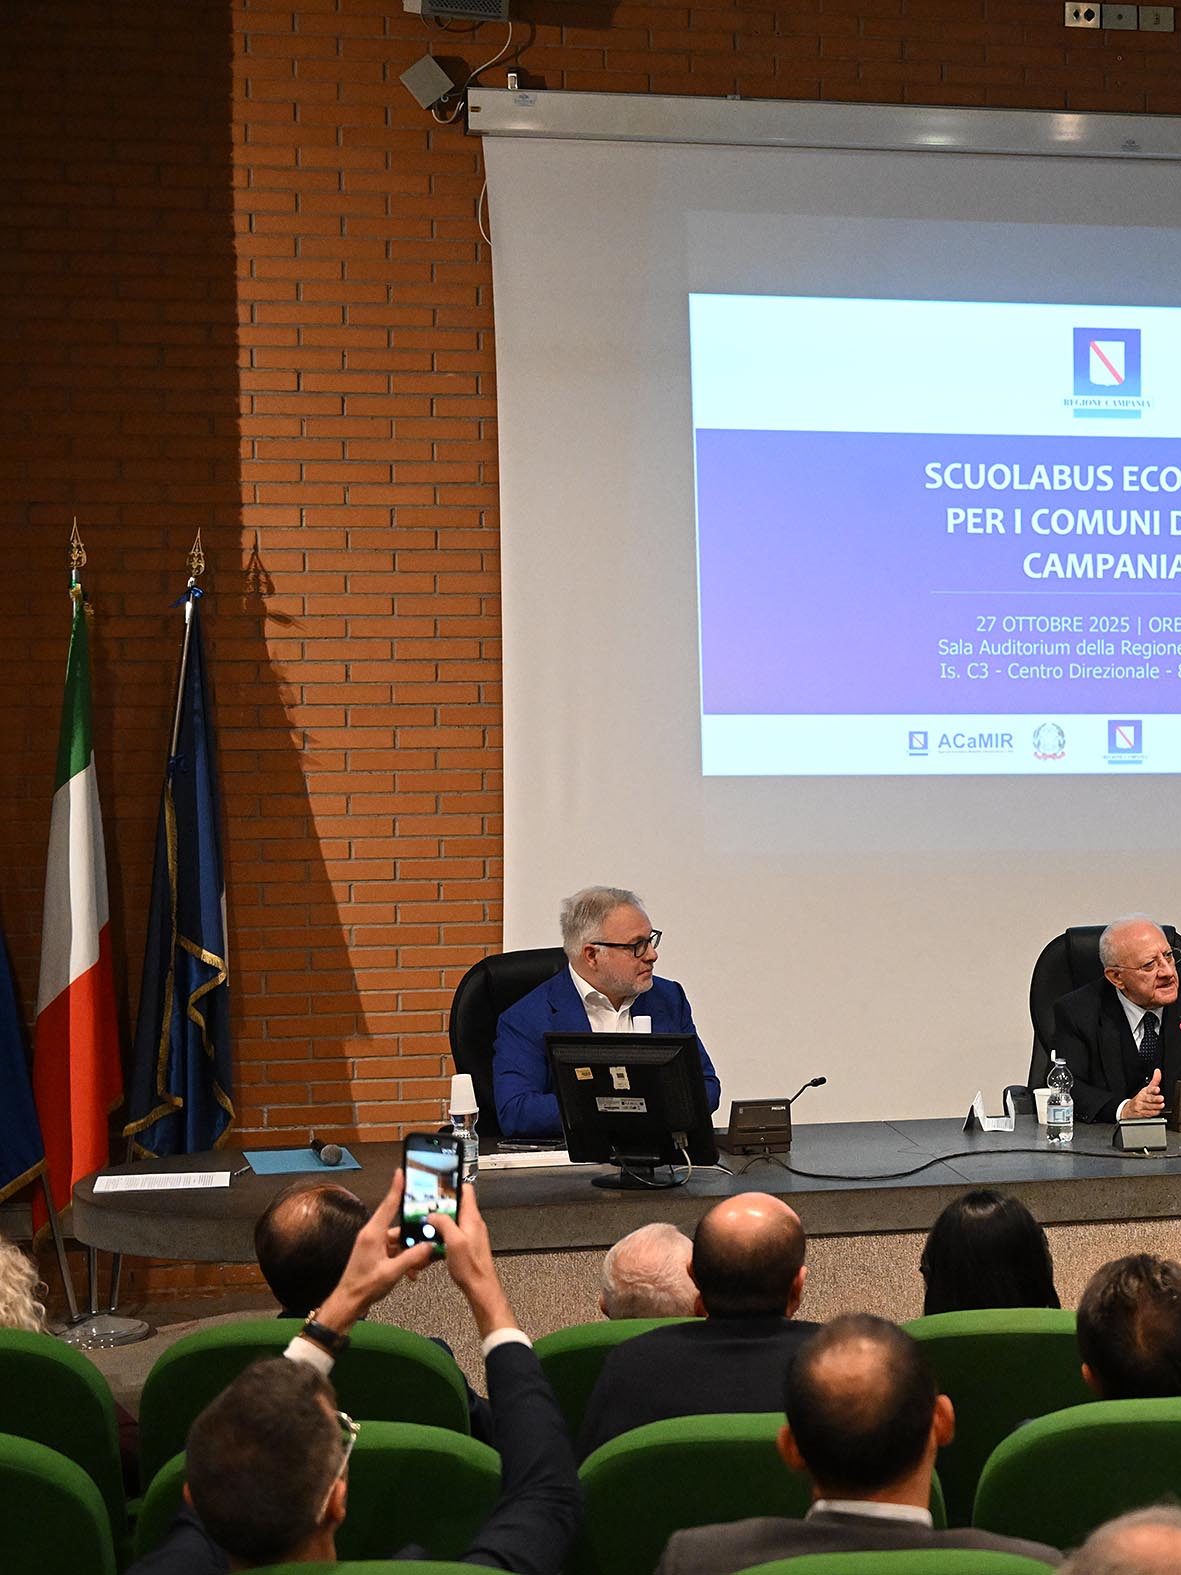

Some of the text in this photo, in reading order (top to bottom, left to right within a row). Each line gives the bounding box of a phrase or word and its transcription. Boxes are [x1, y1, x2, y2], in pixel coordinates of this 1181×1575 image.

[1063, 398, 1101, 407] REGIONE
[925, 462, 1114, 492] SCUOLABUS
[946, 507, 1006, 534] PER
[1014, 508, 1022, 535] I
[1031, 508, 1160, 536] COMUNI
[976, 615, 997, 632] 27
[1002, 615, 1084, 633] OTTOBRE
[1088, 615, 1131, 633] 2025
[938, 637, 973, 656] Sala
[978, 638, 1071, 657] Auditorium
[1075, 639, 1115, 656] della
[940, 663, 961, 680] Is.
[967, 663, 990, 680] C3
[1007, 663, 1063, 680] Centro
[1069, 663, 1160, 680] Direzionale
[937, 733, 1014, 749] ACaMIR
